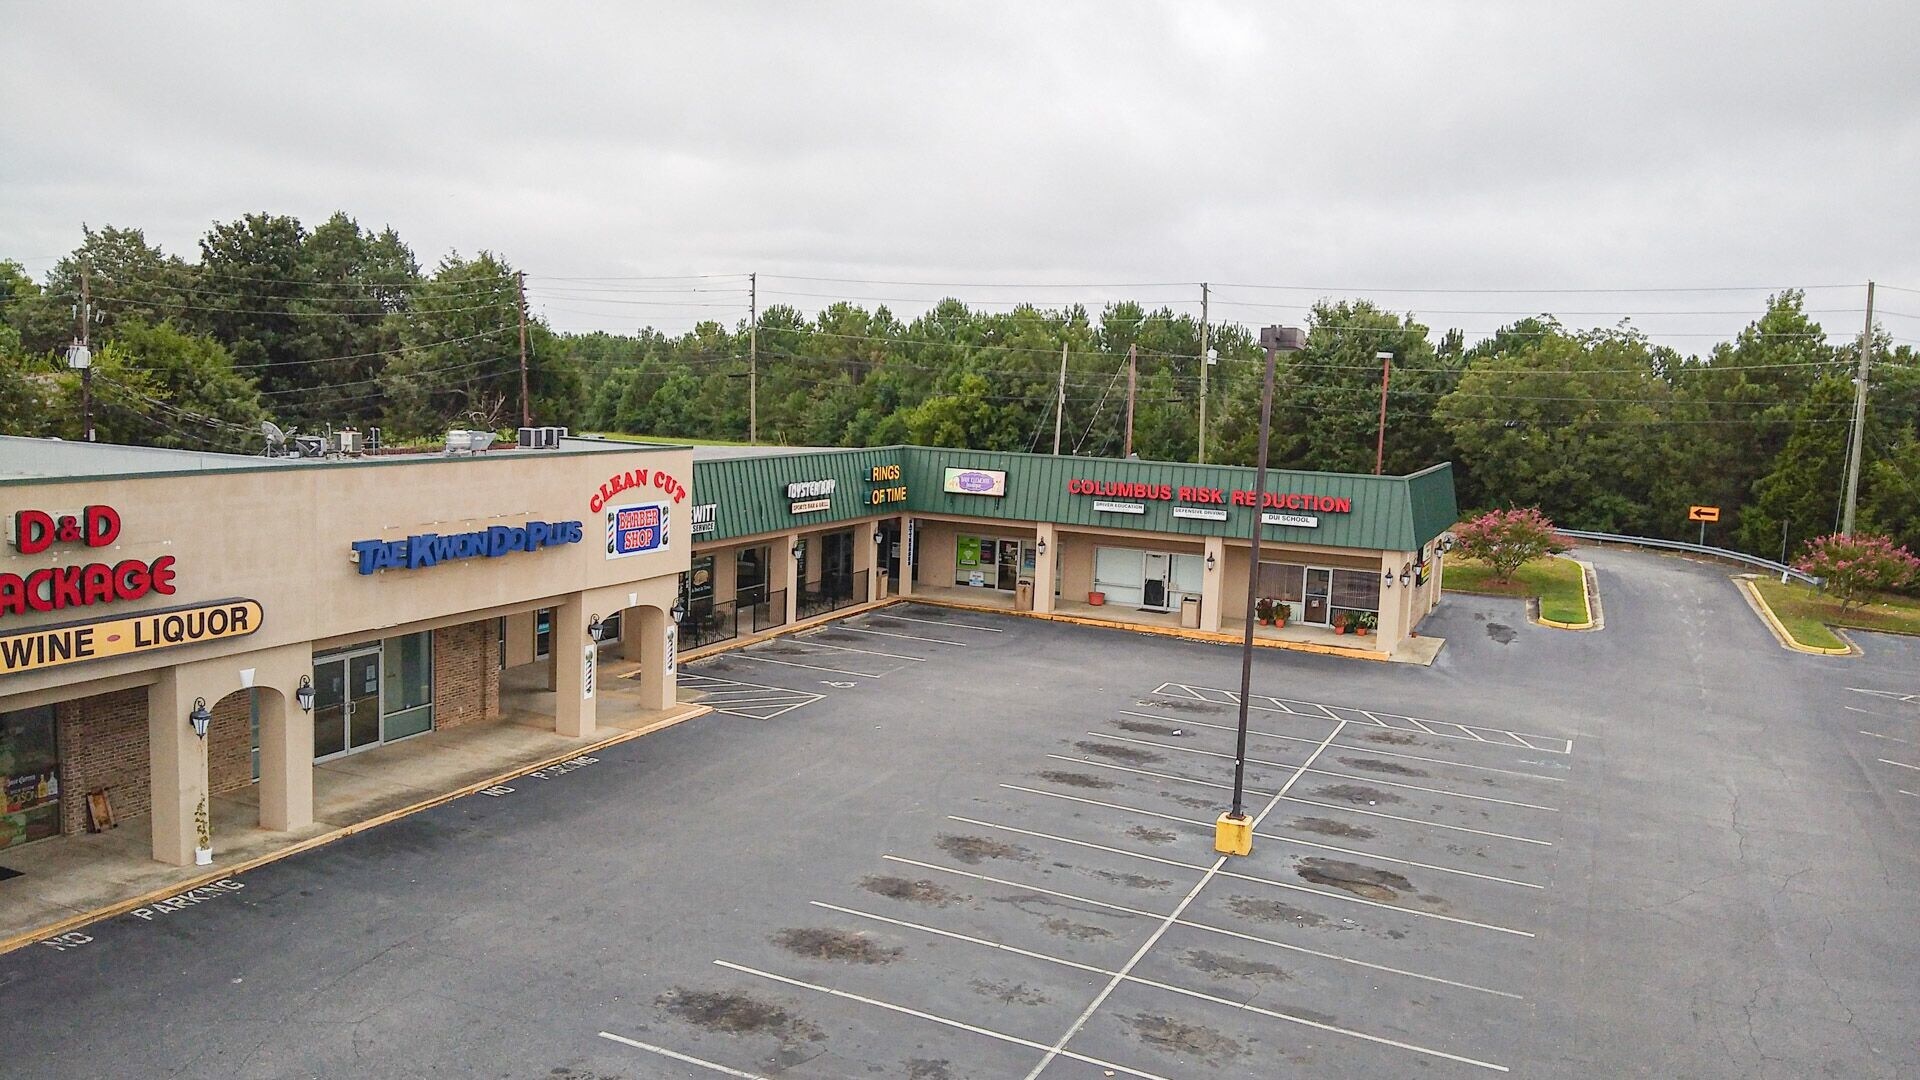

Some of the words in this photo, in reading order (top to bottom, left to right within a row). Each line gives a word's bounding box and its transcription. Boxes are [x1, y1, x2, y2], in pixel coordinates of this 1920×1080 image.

[872, 465, 900, 482] RINGS
[590, 469, 649, 513] CLEAN
[653, 471, 687, 504] CUT
[872, 489, 886, 505] OF
[886, 486, 907, 503] TIME
[1068, 479, 1172, 501] COLUMBUS
[1178, 486, 1224, 505] RISK
[1230, 489, 1351, 514] REDUCTION
[15, 504, 122, 555] D&D
[618, 508, 659, 531] BARBER
[692, 522, 714, 533] SERVICE
[1281, 516, 1310, 524] SCHOOL
[624, 528, 654, 549] SHOP
[0, 628, 95, 669] WINE
[134, 606, 248, 648] LIQUOR
